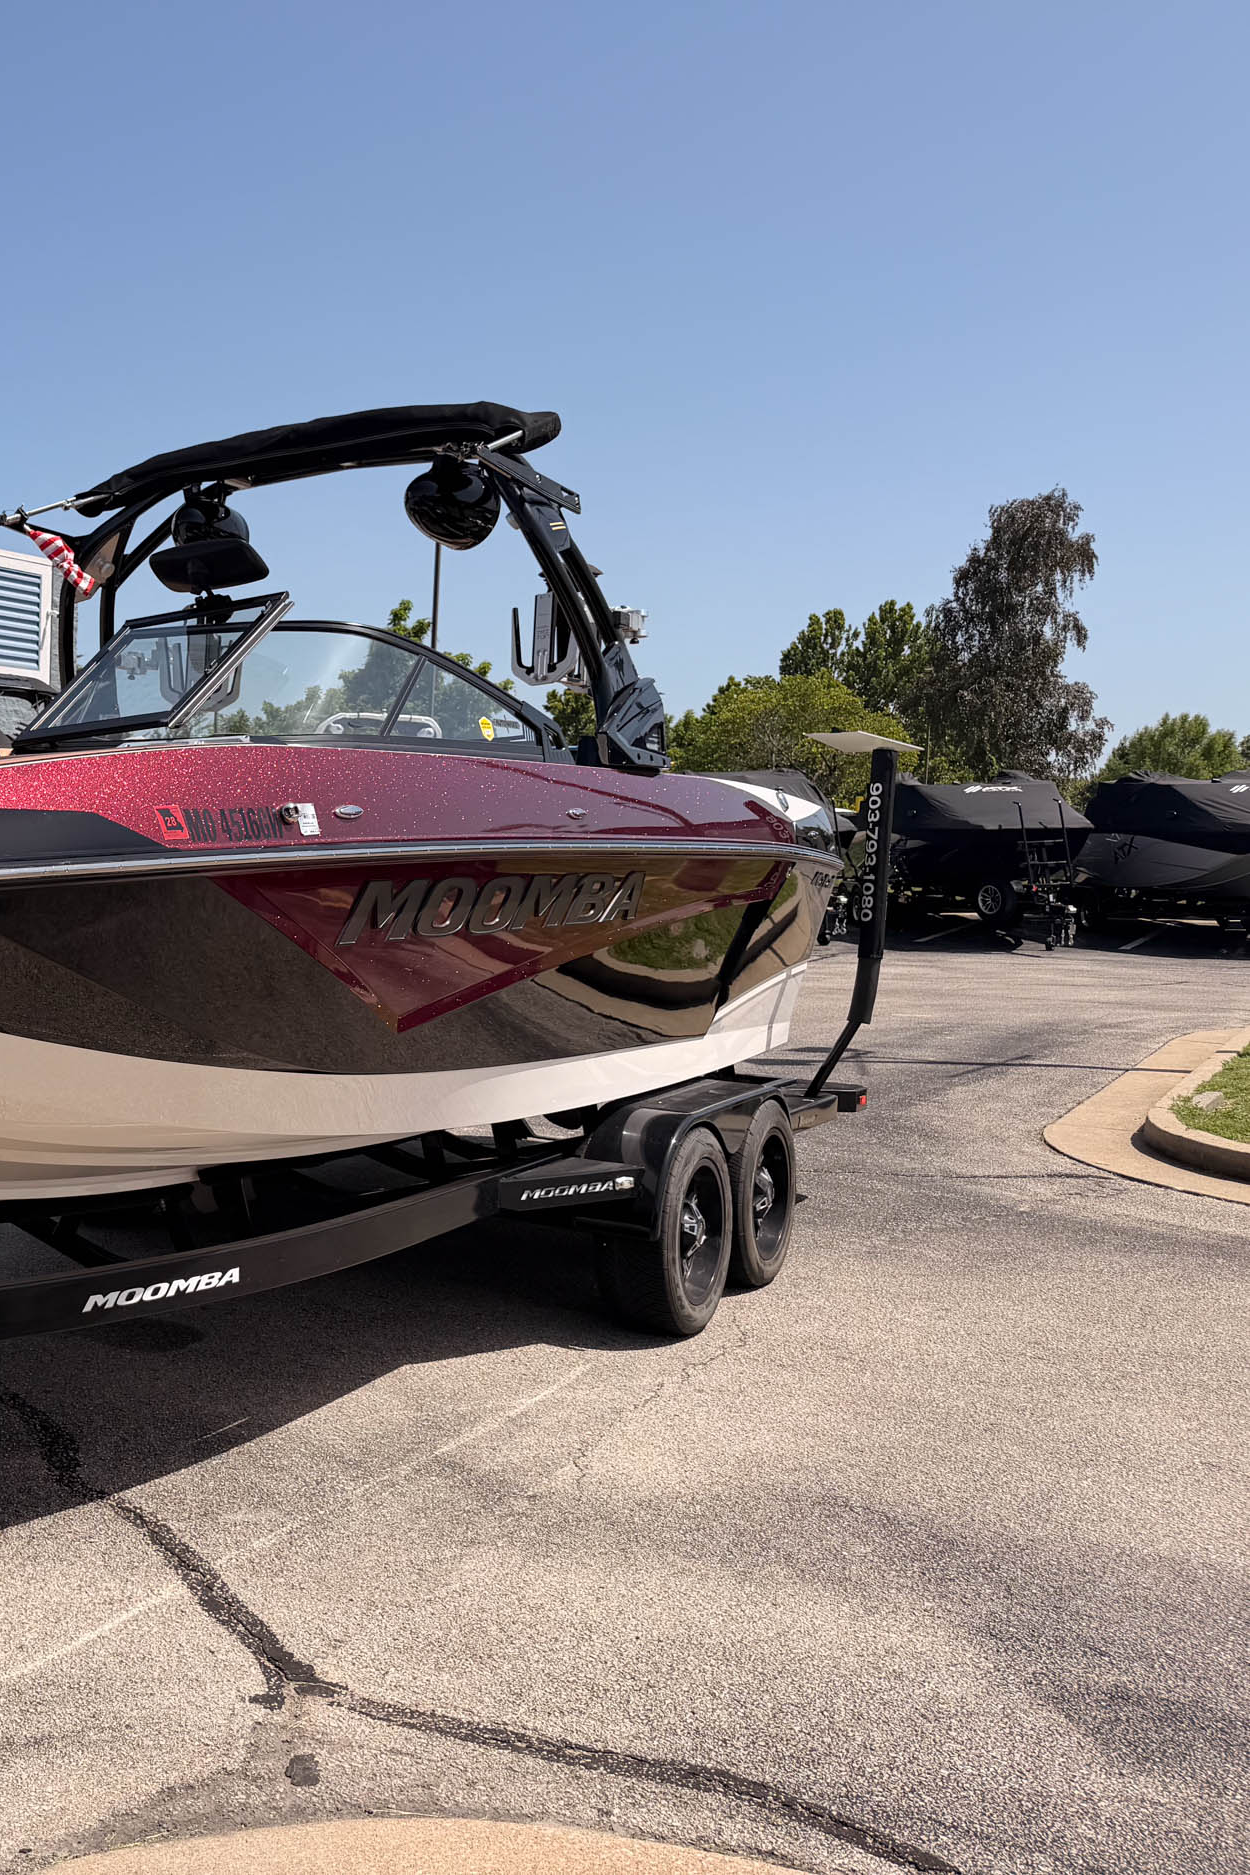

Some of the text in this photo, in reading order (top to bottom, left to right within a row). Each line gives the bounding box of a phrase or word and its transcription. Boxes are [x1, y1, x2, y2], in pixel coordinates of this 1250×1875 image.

[182, 808, 217, 843] MO
[860, 782, 883, 922] 903-793-1080
[335, 871, 646, 947] MOOMBA
[521, 1180, 614, 1201] MOOMBA
[81, 1266, 240, 1313] MOOMBA
